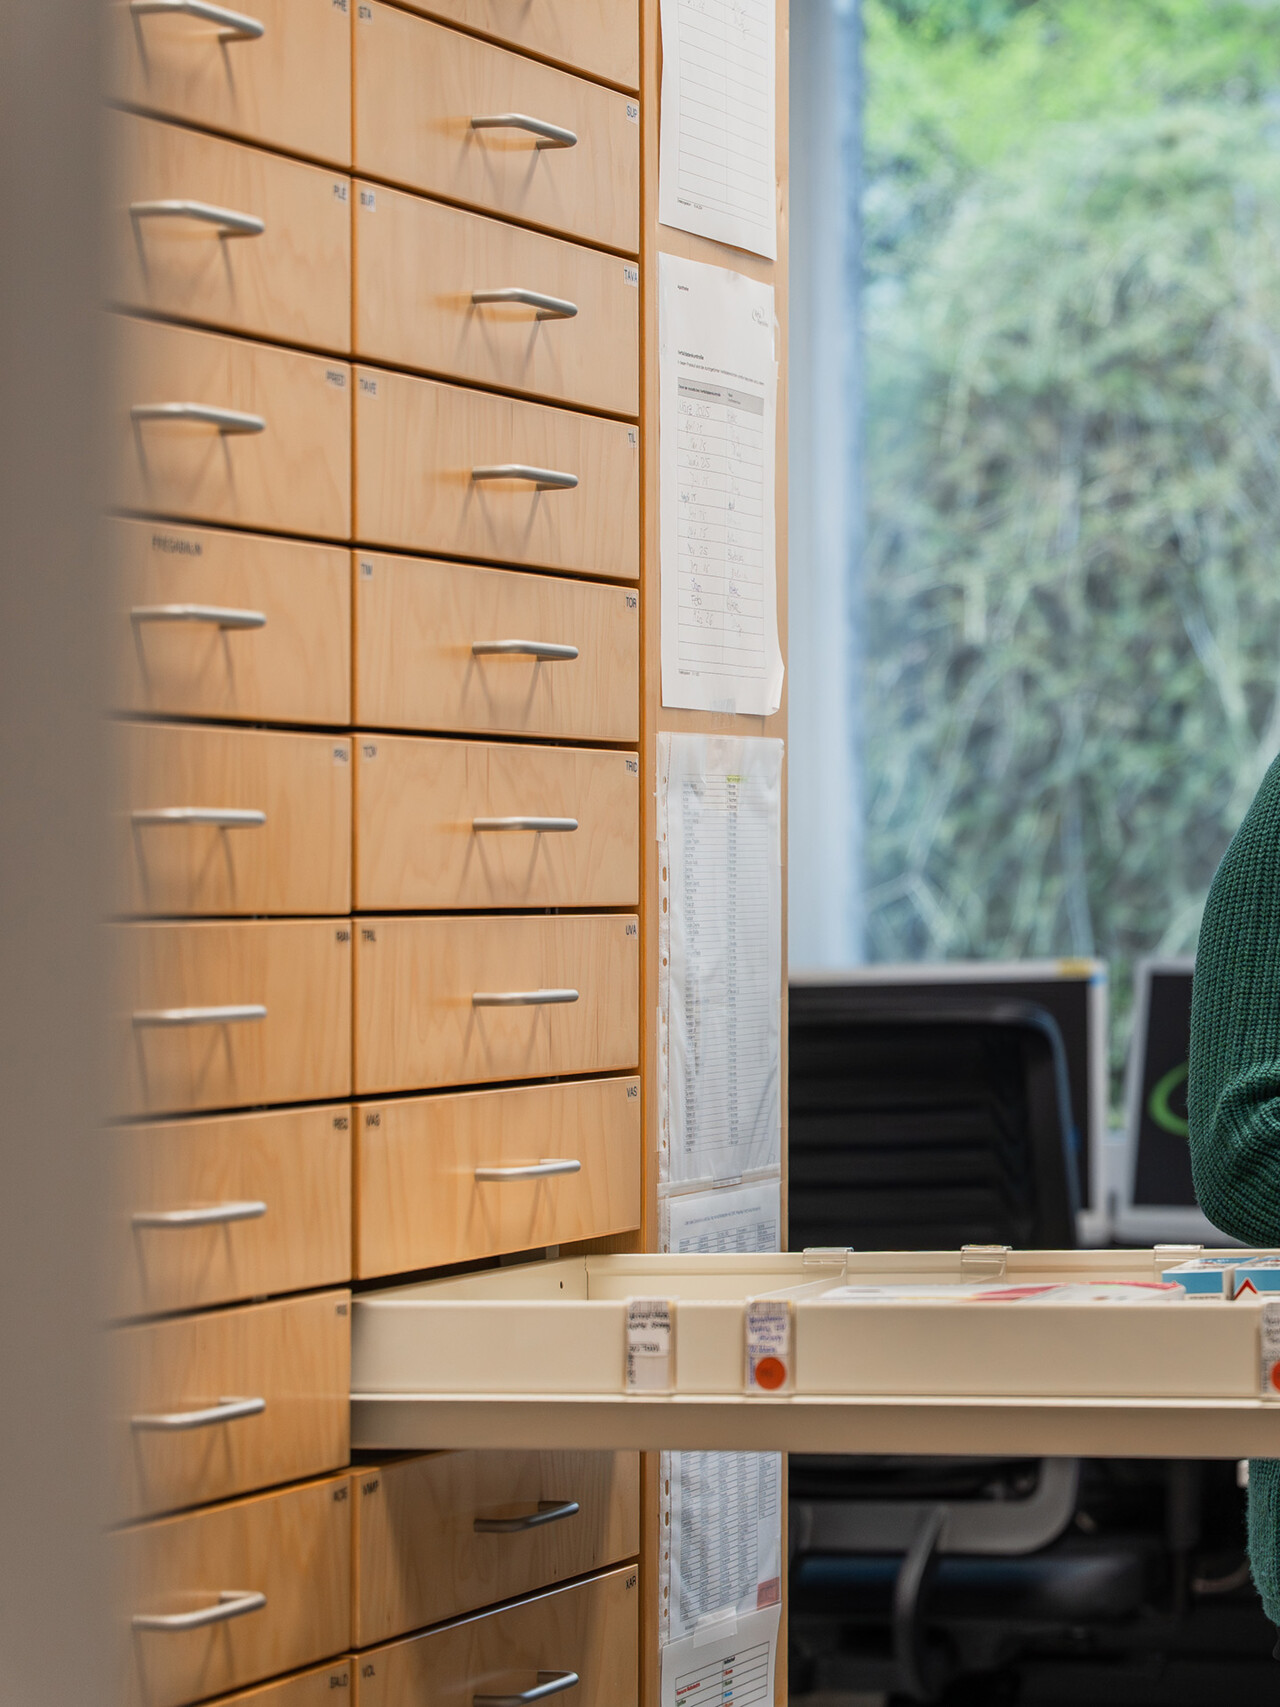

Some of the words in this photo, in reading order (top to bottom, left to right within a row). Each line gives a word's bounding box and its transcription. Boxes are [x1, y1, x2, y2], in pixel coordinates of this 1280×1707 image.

[626, 105, 638, 119] SUP
[626, 596, 638, 609] TOR
[626, 1085, 638, 1099] VAS
[625, 1575, 637, 1591] XAR
